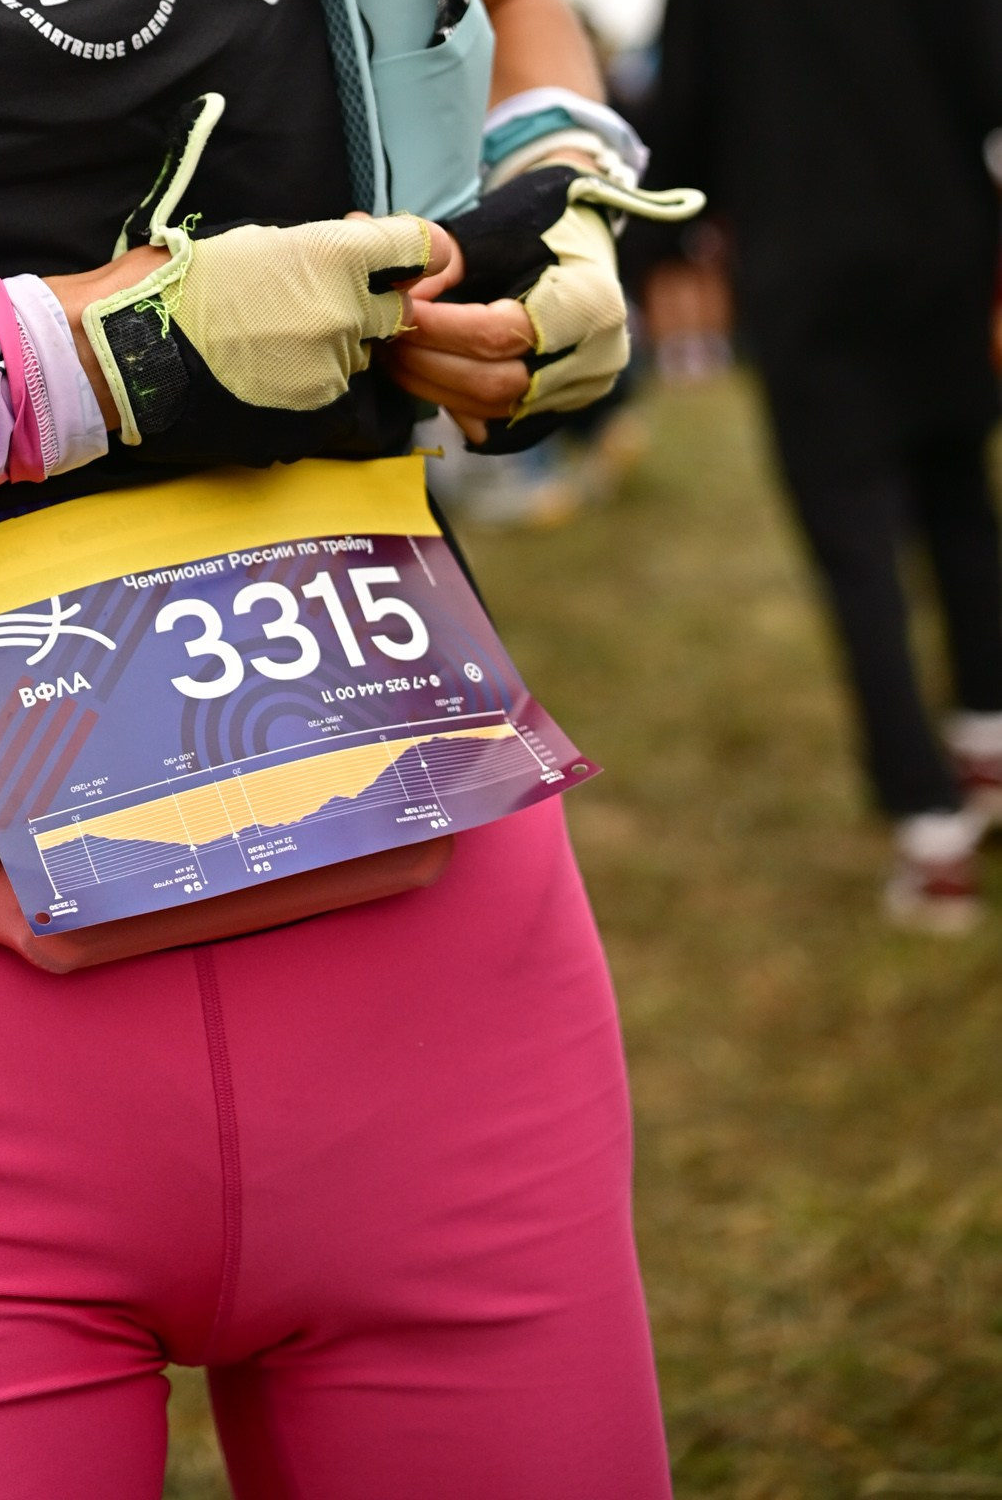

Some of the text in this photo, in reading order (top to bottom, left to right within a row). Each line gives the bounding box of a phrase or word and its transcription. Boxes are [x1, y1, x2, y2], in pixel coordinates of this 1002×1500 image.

[19, 7, 126, 60] CHARTREUSE
[122, 535, 374, 591] Чемпионат России по трейлу
[155, 566, 429, 699] 3315
[18, 671, 92, 708] ВФЛА
[321, 675, 427, 703] +7 925 444 00 11
[163, 757, 173, 766] 90
[175, 763, 186, 771] км
[232, 767, 241, 775] 20
[70, 783, 88, 793] 1260
[85, 789, 96, 797] км
[28, 827, 37, 835] 33
[274, 838, 284, 846] км
[284, 836, 293, 844] 22
[250, 844, 297, 861] Приют ветров
[186, 864, 195, 872] 24
[153, 872, 198, 889] Юрьев хутор
